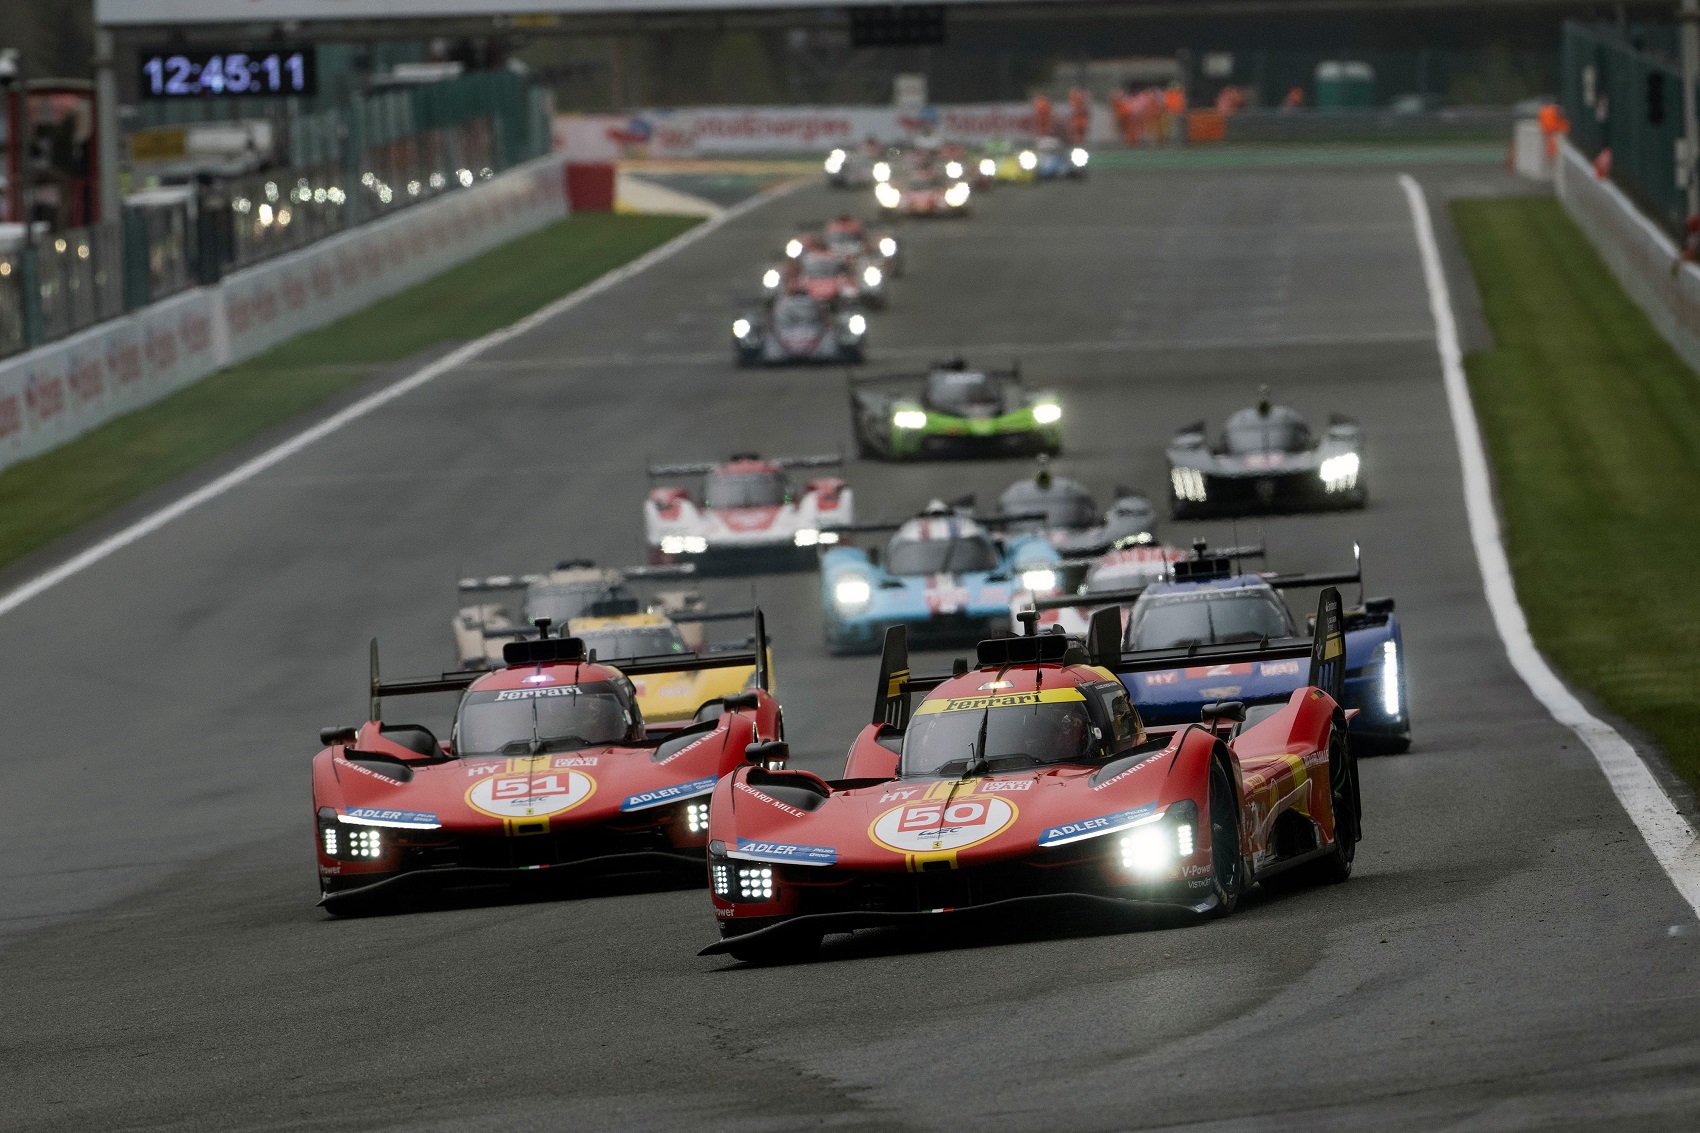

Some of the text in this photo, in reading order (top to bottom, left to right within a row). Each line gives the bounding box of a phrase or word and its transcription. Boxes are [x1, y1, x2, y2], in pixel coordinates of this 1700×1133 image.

[142, 53, 304, 95] 12:45:11
[494, 685, 583, 701] Ferrari
[944, 691, 1043, 711] Ferrari
[660, 726, 729, 766] RICHARD MILLE
[333, 757, 403, 787] RICHARD MILLE
[468, 765, 499, 777] HY
[1093, 744, 1179, 792] RICHARD MILLE
[496, 776, 566, 797] 51
[629, 787, 681, 805] ADLER
[879, 789, 918, 803] HY
[733, 782, 805, 818] RICHARD MILLE
[349, 809, 402, 820] ADLER
[904, 803, 985, 828] 50
[1048, 818, 1110, 839] ADLER
[740, 843, 797, 855] ADLER
